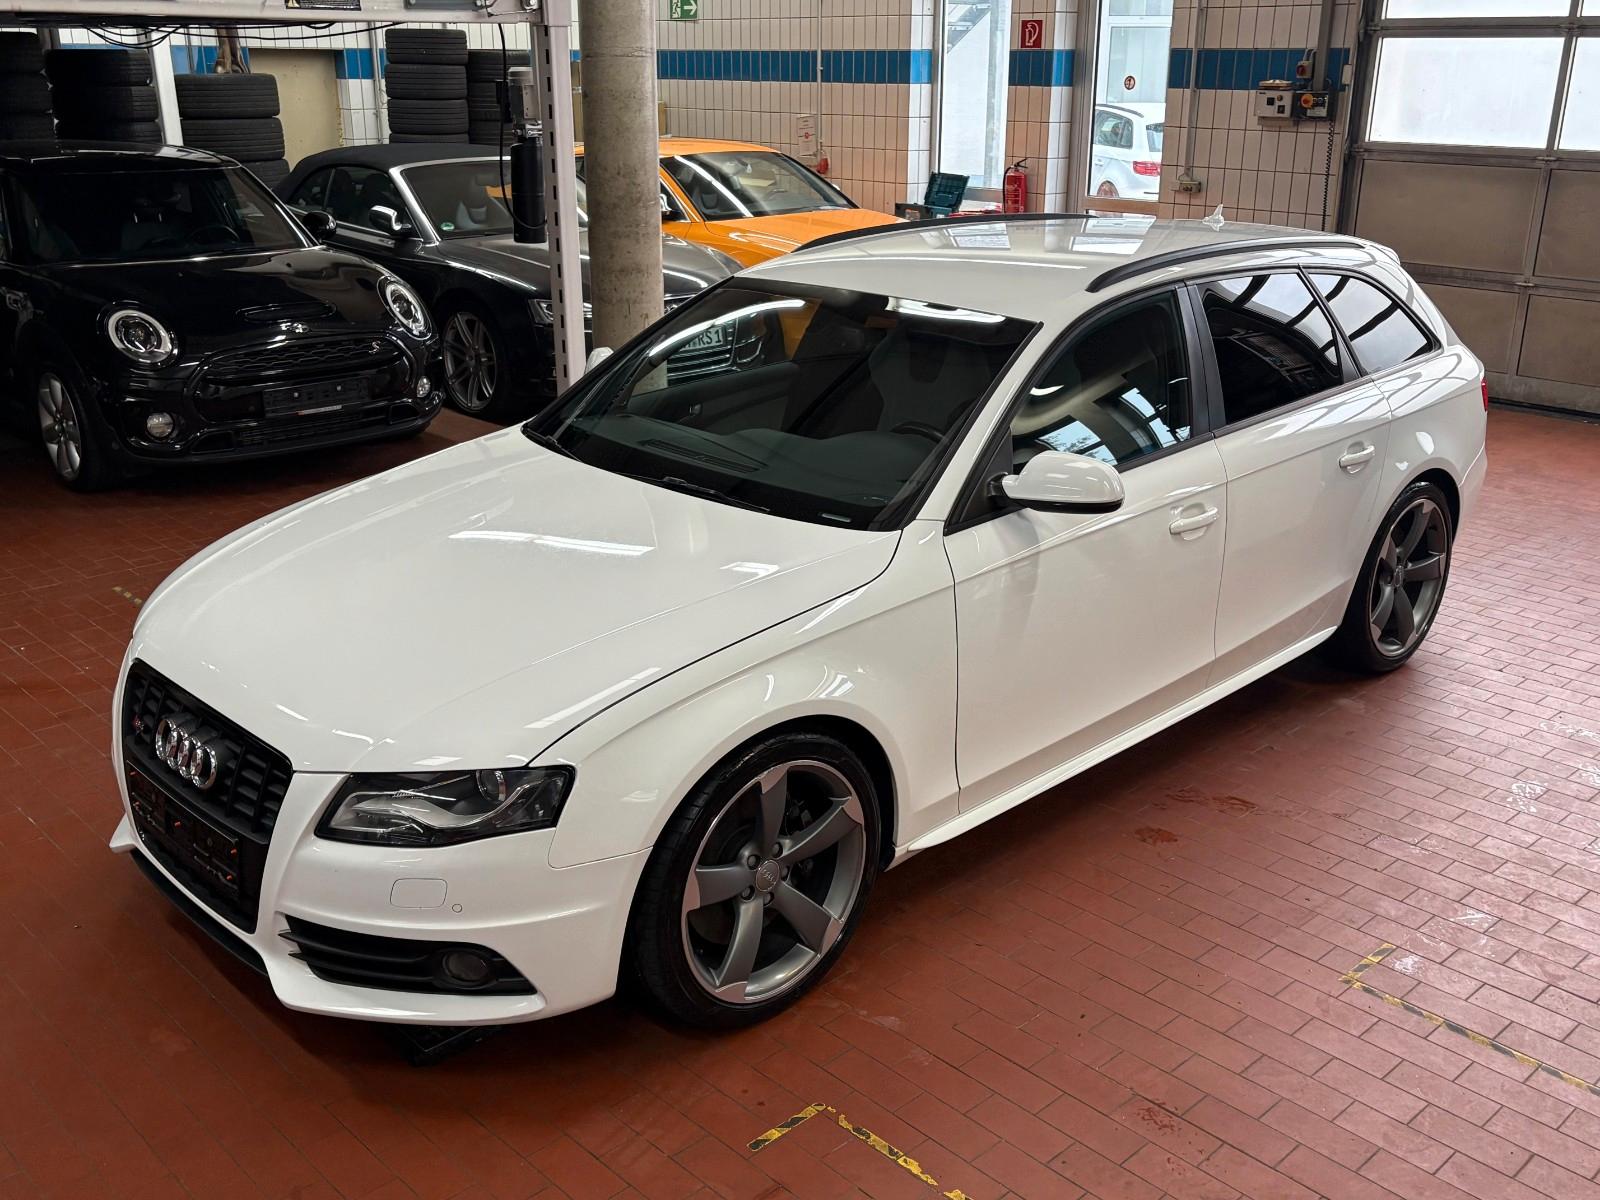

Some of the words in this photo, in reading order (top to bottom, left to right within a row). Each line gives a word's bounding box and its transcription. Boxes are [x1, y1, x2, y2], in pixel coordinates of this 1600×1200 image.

[698, 330, 713, 346] RS
[714, 329, 721, 343] 1
[368, 340, 381, 355] S
